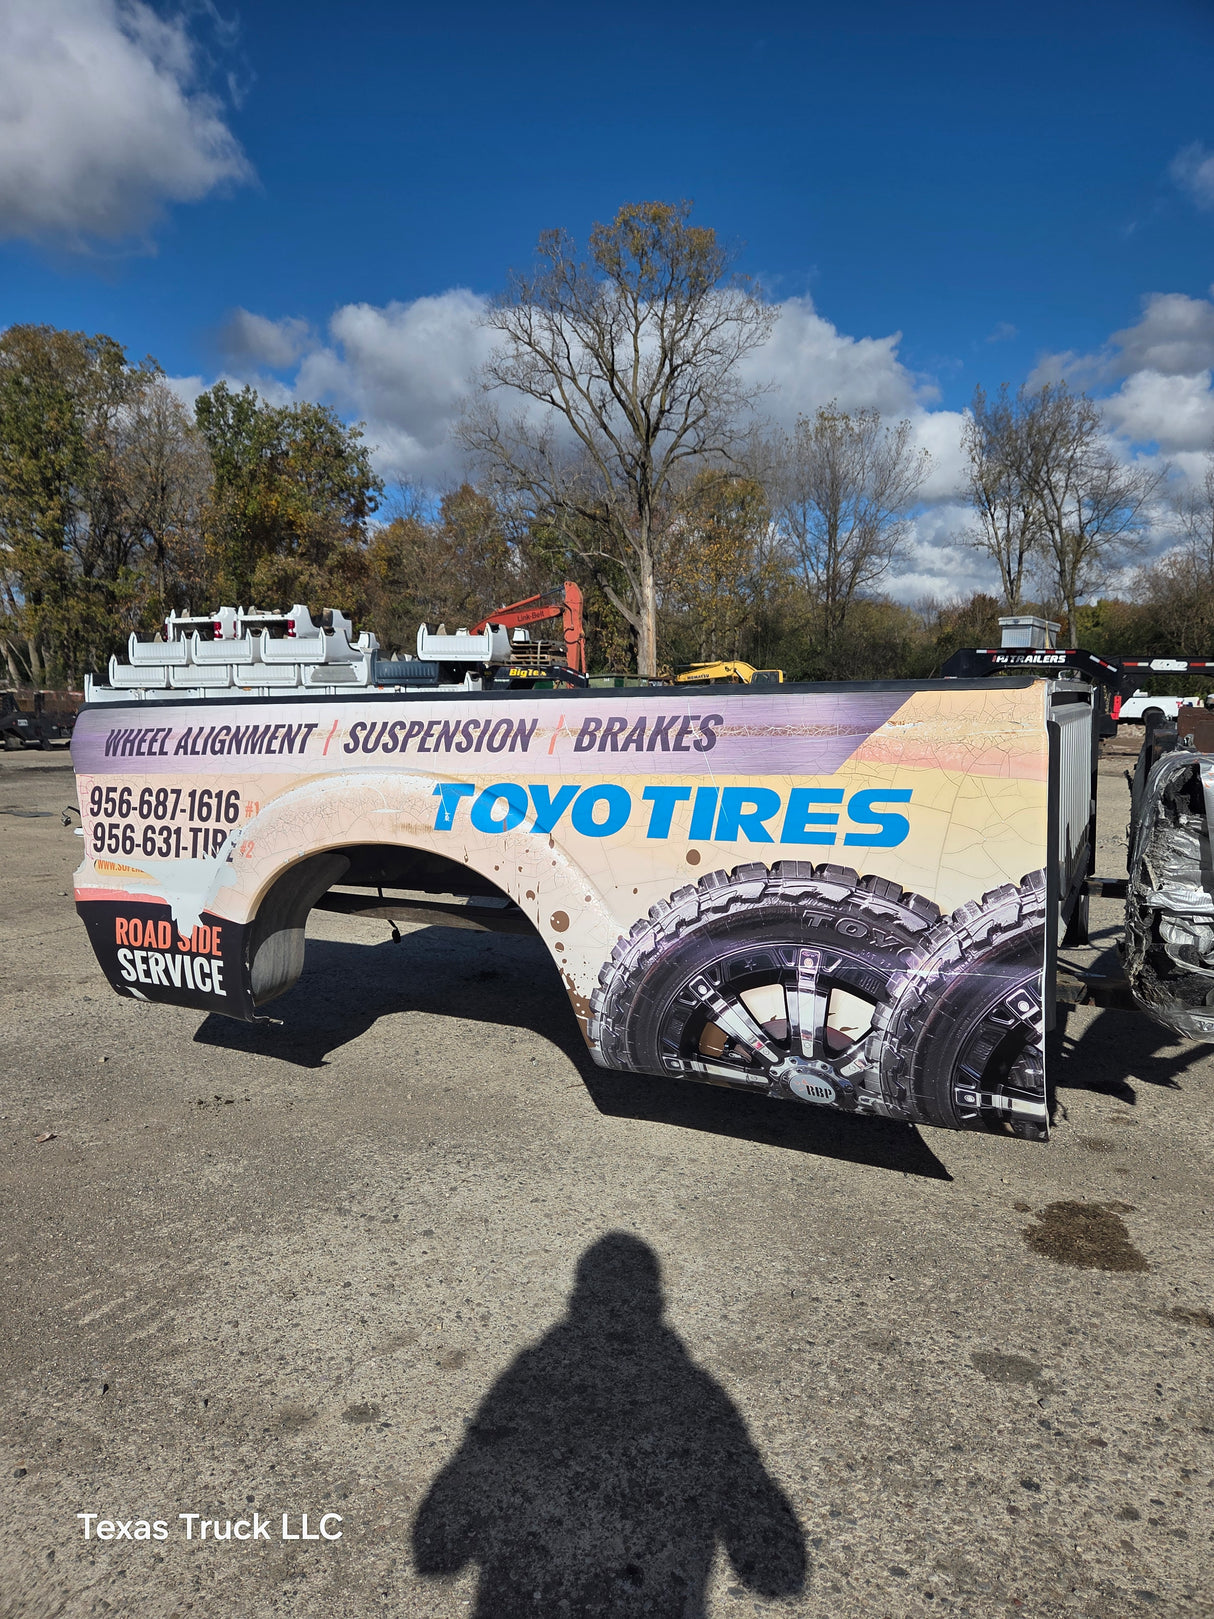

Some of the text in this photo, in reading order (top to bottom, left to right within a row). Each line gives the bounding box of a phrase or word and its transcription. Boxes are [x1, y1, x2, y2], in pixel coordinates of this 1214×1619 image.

[1009, 655, 1067, 663] TRAILERS
[104, 713, 724, 757] WHEEL ALIGNMENT SUSPENSION BRAKES
[89, 785, 240, 823] 956-687-1616
[432, 782, 913, 847] TOYO TIRES
[115, 917, 171, 950] ROAD
[117, 948, 227, 996] SERVICE
